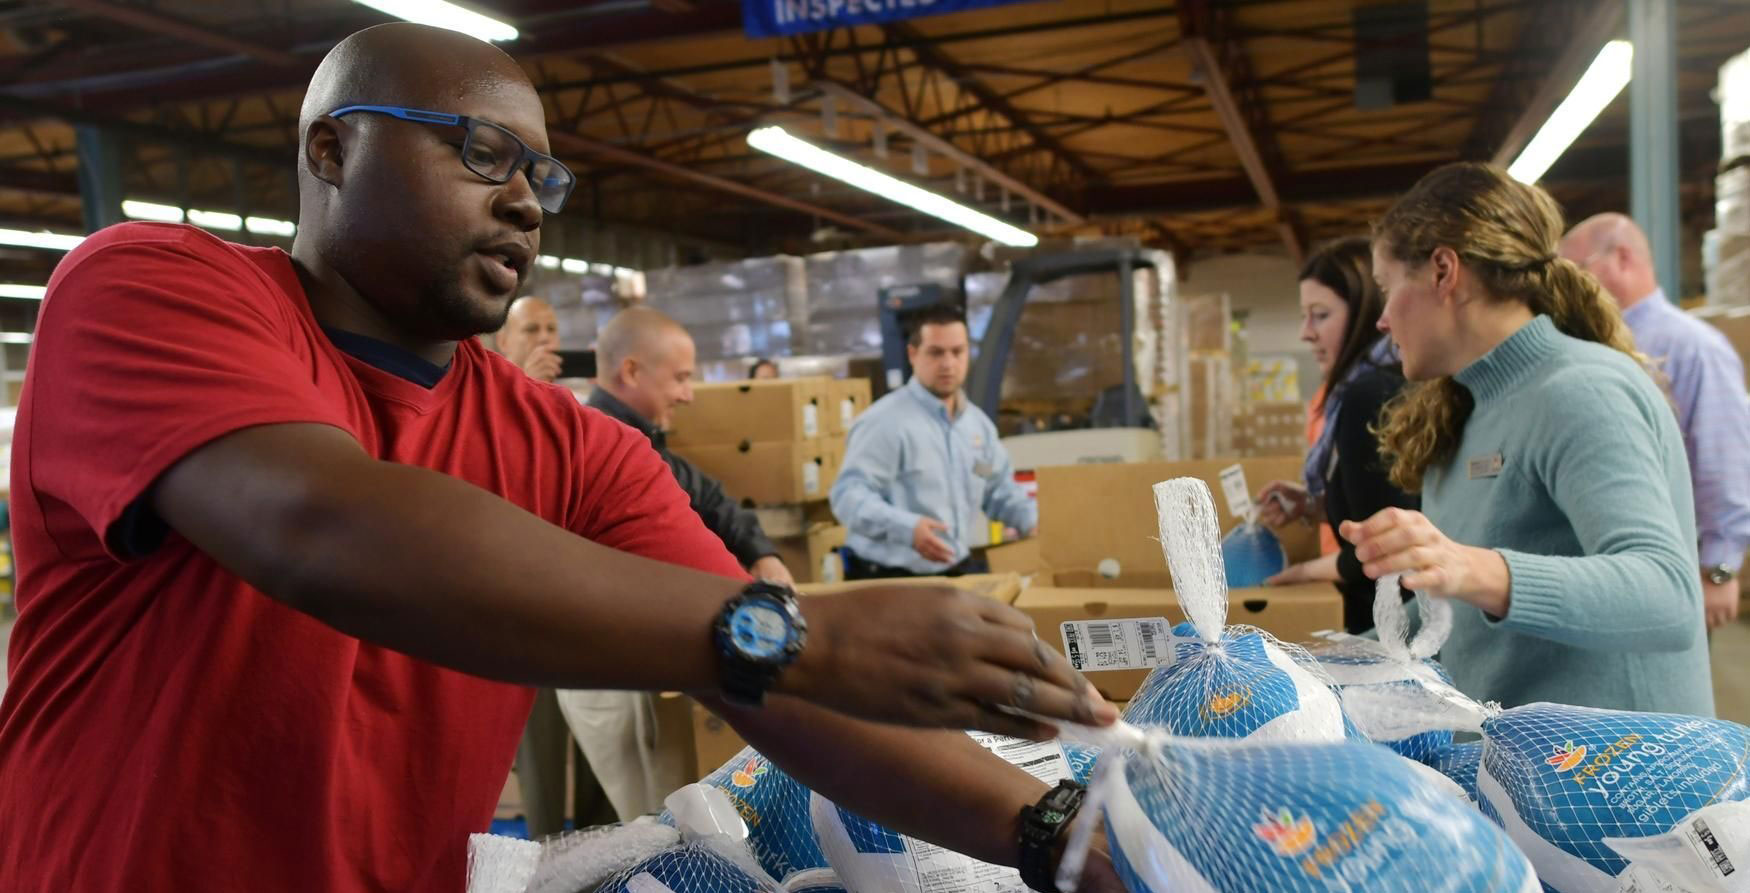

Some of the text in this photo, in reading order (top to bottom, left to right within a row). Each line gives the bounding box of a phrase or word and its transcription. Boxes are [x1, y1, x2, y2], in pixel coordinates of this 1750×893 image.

[774, 0, 934, 23] INSPEC
[1573, 733, 1644, 785] FROZEN
[1588, 742, 1665, 799] young
[1638, 788, 1680, 822] giblets
